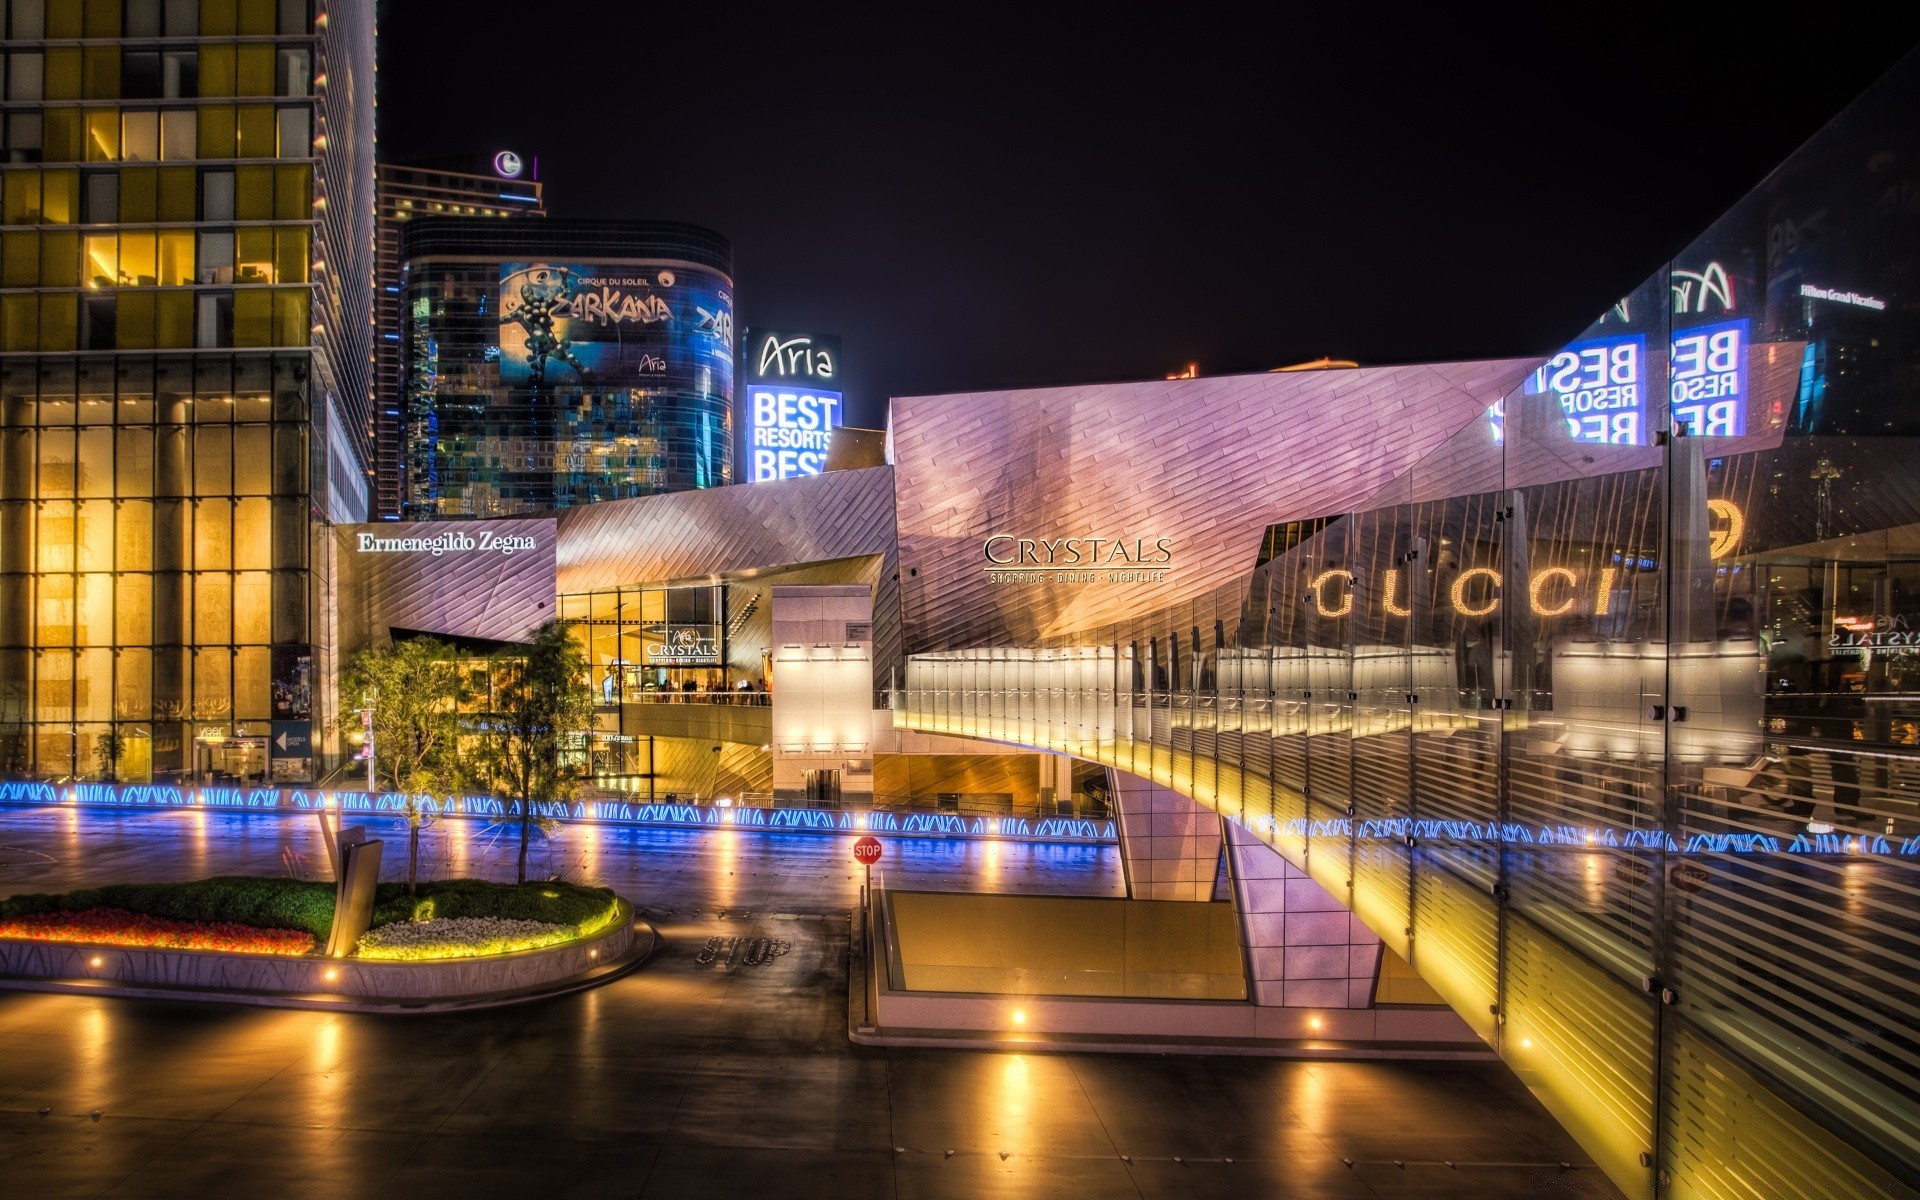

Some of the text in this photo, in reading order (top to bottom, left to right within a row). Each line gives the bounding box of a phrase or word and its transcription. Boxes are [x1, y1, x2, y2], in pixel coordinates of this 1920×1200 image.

[577, 278, 649, 287] CIRQUE DU SOLEIL
[1800, 284, 1827, 299] Hilton
[1828, 288, 1850, 304] Grand
[550, 286, 674, 327] ZARKANA
[638, 353, 666, 373] Aria
[758, 336, 833, 377] Aria
[754, 392, 838, 431] BEST
[357, 531, 536, 556] Ermenegildo Zegna
[983, 533, 1172, 565] CRYSTALS
[990, 571, 1164, 584] SHOPPING DINING NIGHTLIFE
[855, 845, 881, 857] STOP
[695, 936, 791, 967] STOP
